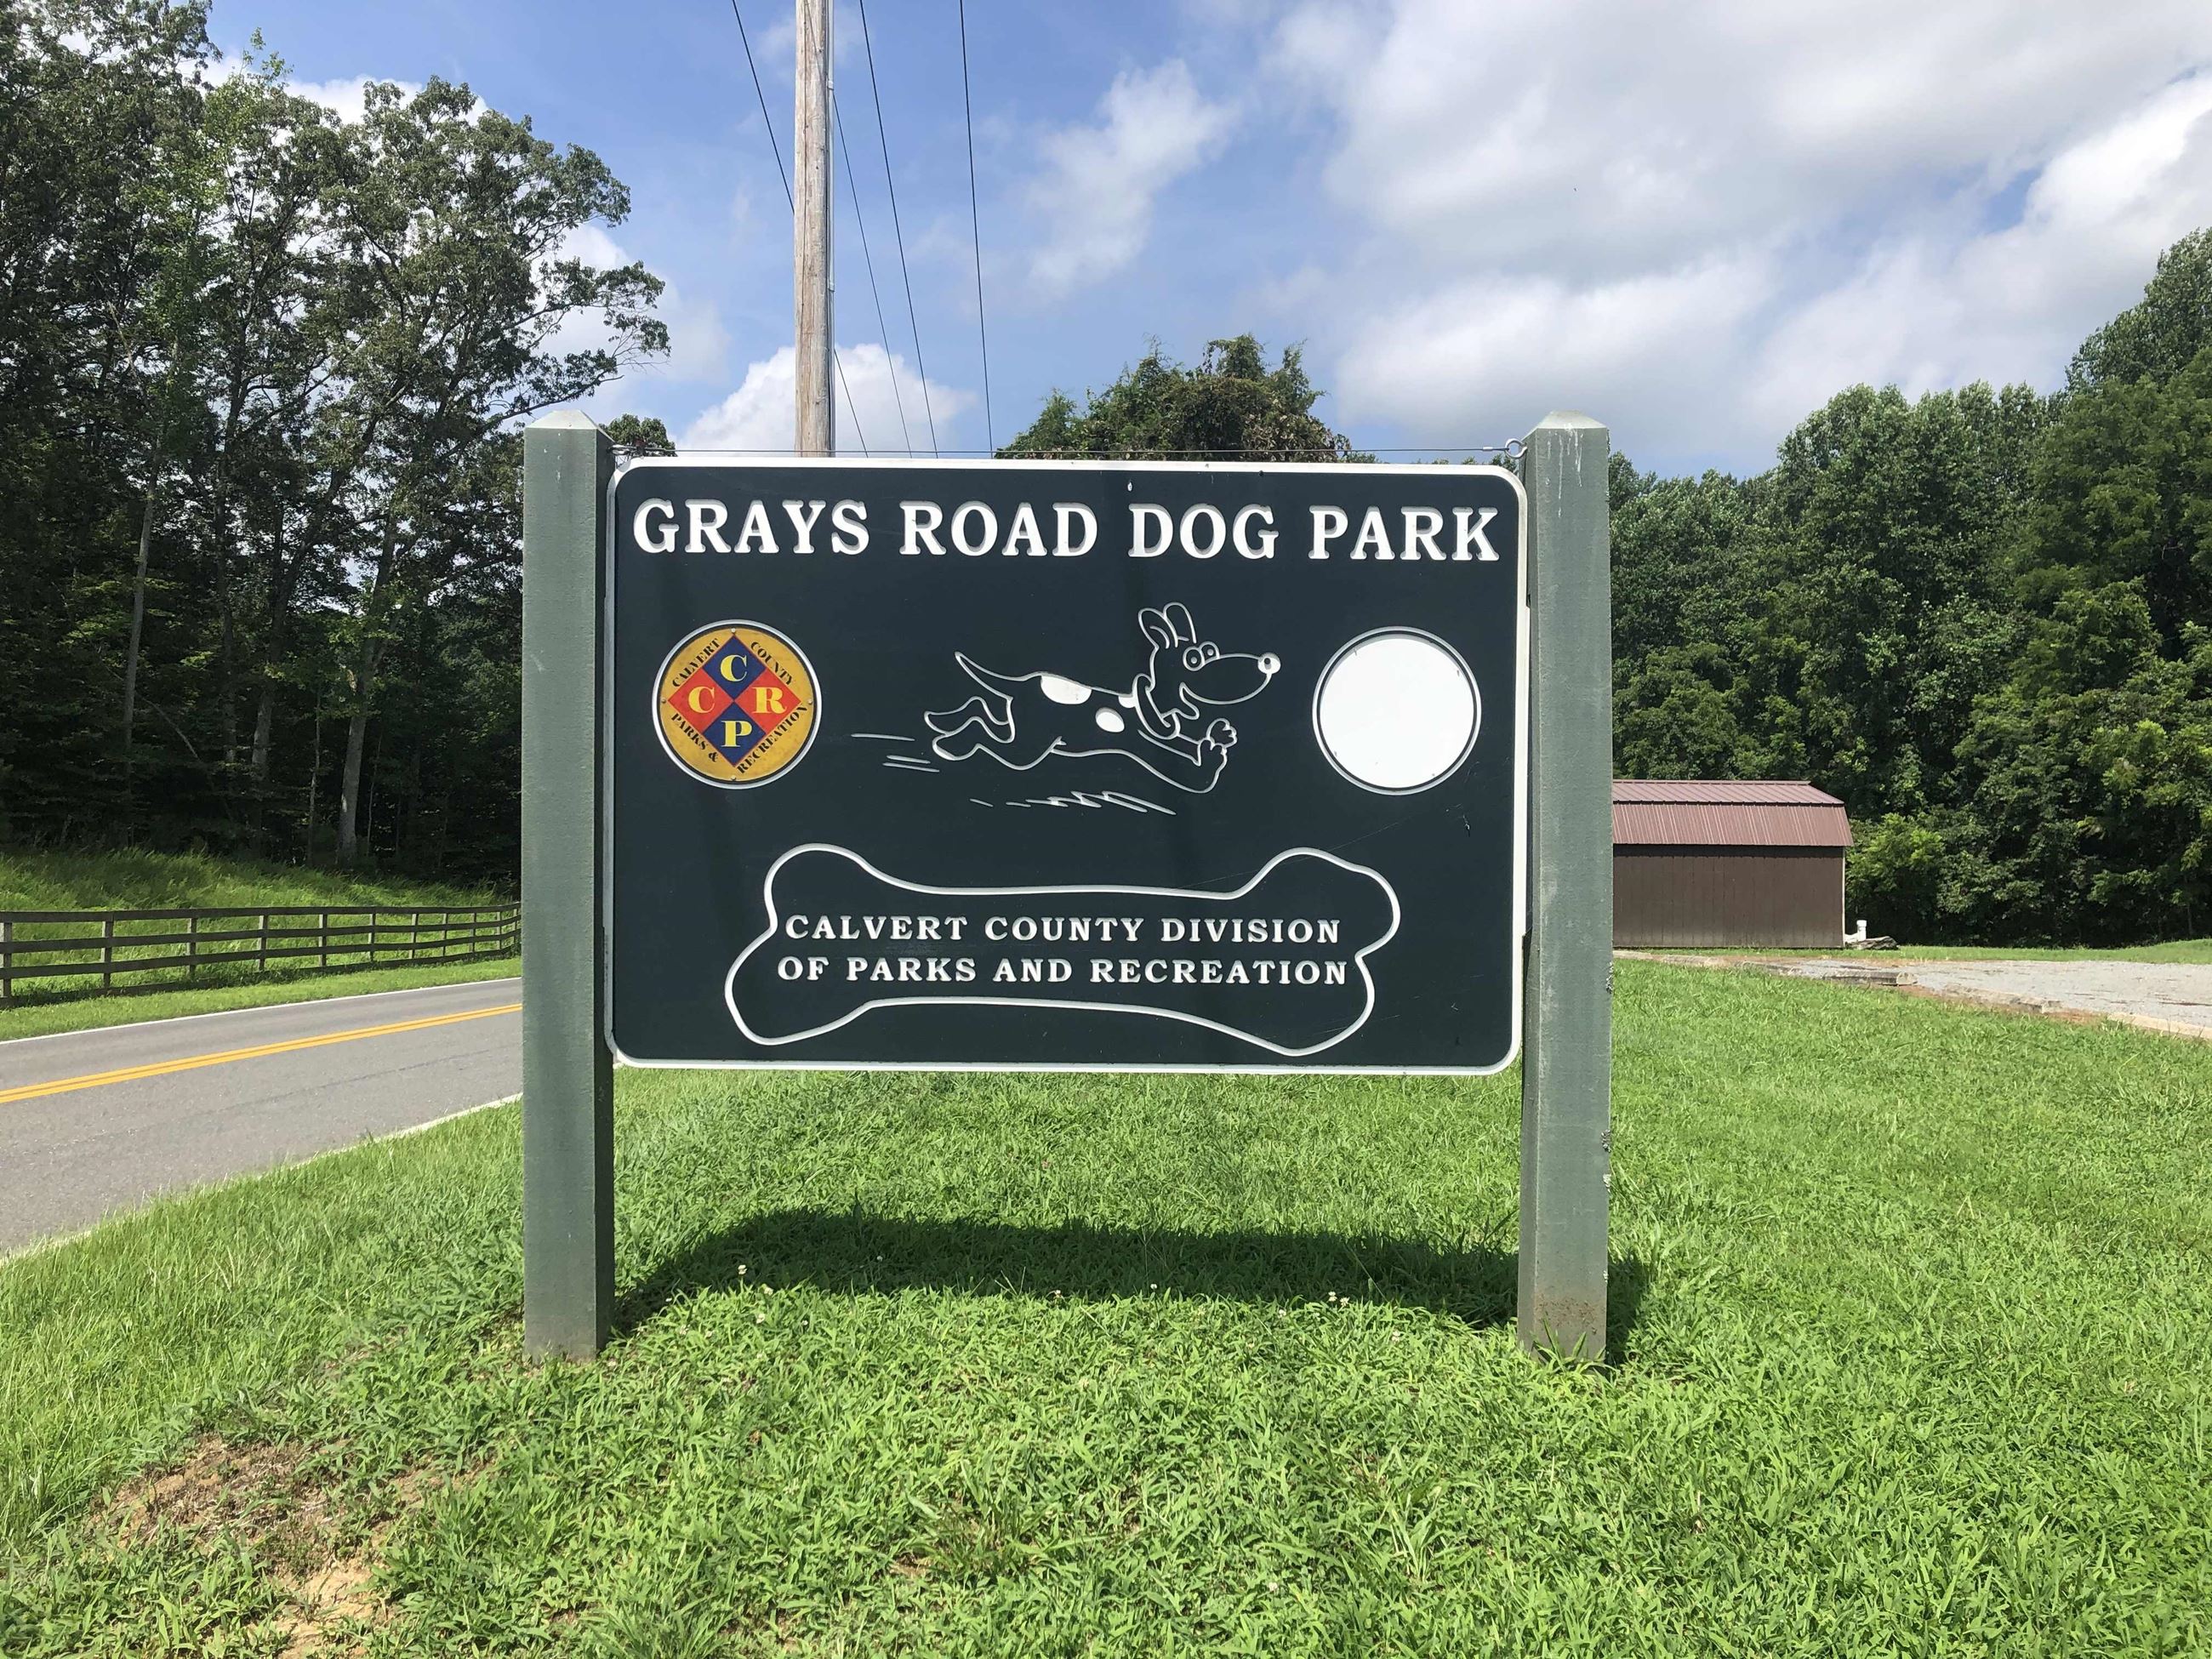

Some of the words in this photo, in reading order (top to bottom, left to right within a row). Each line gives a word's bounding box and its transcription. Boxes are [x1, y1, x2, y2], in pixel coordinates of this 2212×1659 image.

[632, 498, 869, 556] GRAYS
[898, 500, 1098, 557] ROAD
[1127, 503, 1280, 560] DOG
[1308, 505, 1500, 562] PARK
[672, 638, 720, 687] CALVERT
[750, 641, 793, 686] COUNTY
[720, 654, 748, 682] C
[688, 686, 715, 714] C
[752, 687, 787, 714] R
[671, 713, 708, 750] PARKS
[708, 751, 719, 762] &
[737, 705, 807, 773] RECREATION
[721, 720, 752, 748] P
[784, 914, 968, 941] CALVERT
[984, 915, 1144, 942] COUNTY
[1160, 917, 1341, 944] DIVISION
[777, 955, 830, 981] OF
[846, 956, 977, 982] PARKS
[992, 958, 1073, 983] AND
[1089, 958, 1348, 985] RECREATION
